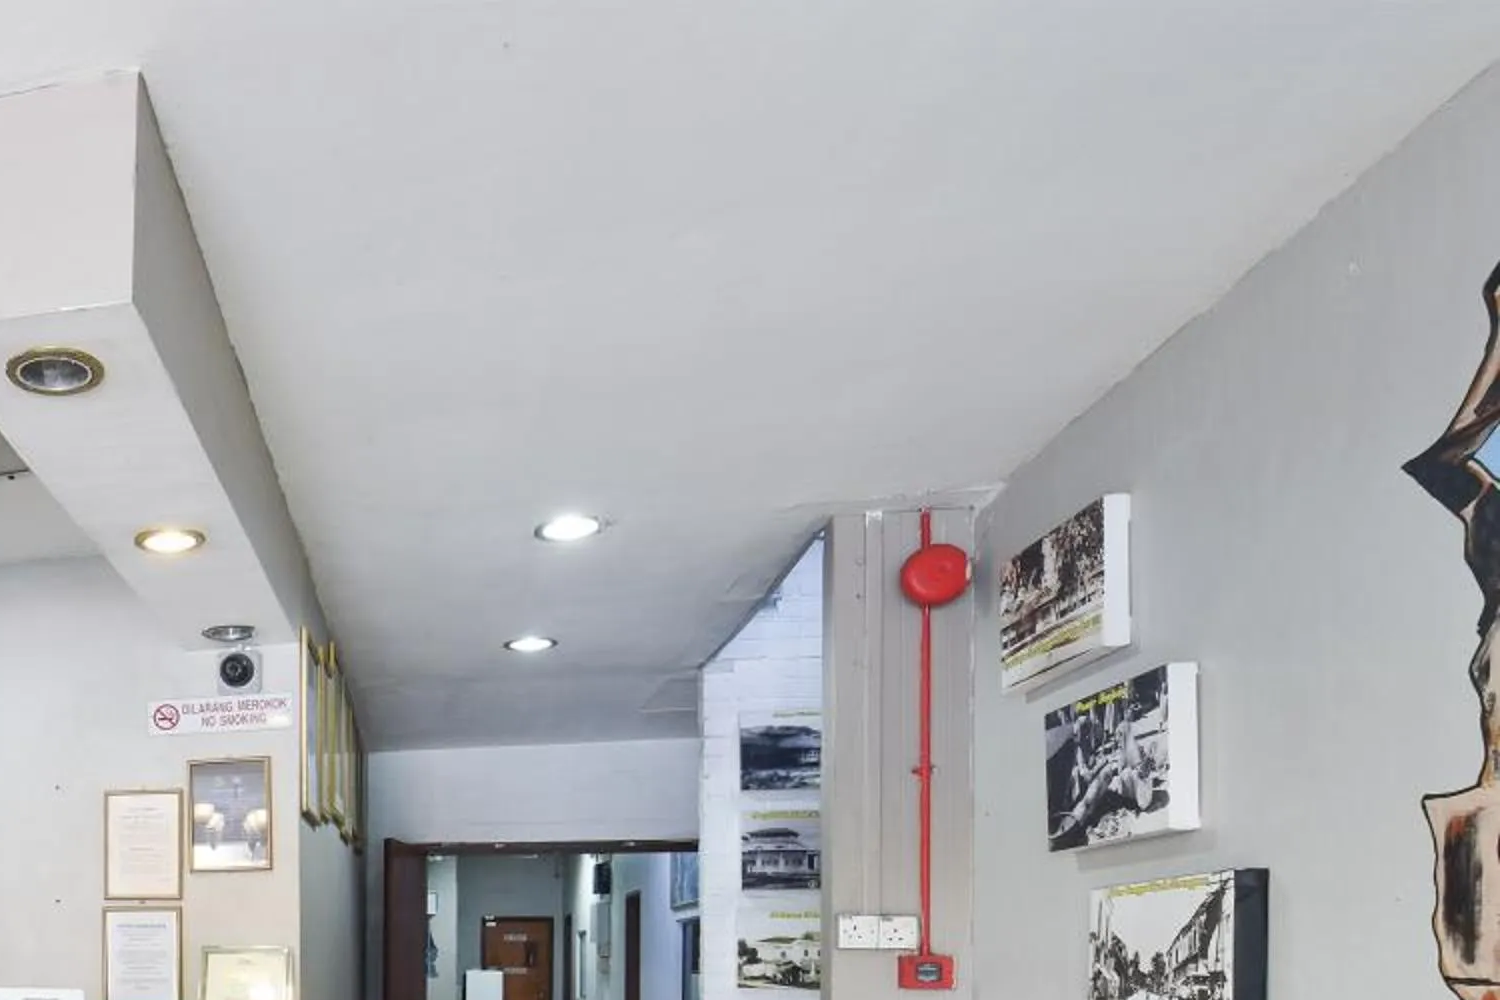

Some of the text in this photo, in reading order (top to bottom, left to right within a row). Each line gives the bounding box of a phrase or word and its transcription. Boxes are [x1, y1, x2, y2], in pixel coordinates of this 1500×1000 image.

[181, 697, 287, 715] DILARANG MEROKOK
[201, 713, 268, 727] NO SMOKING
